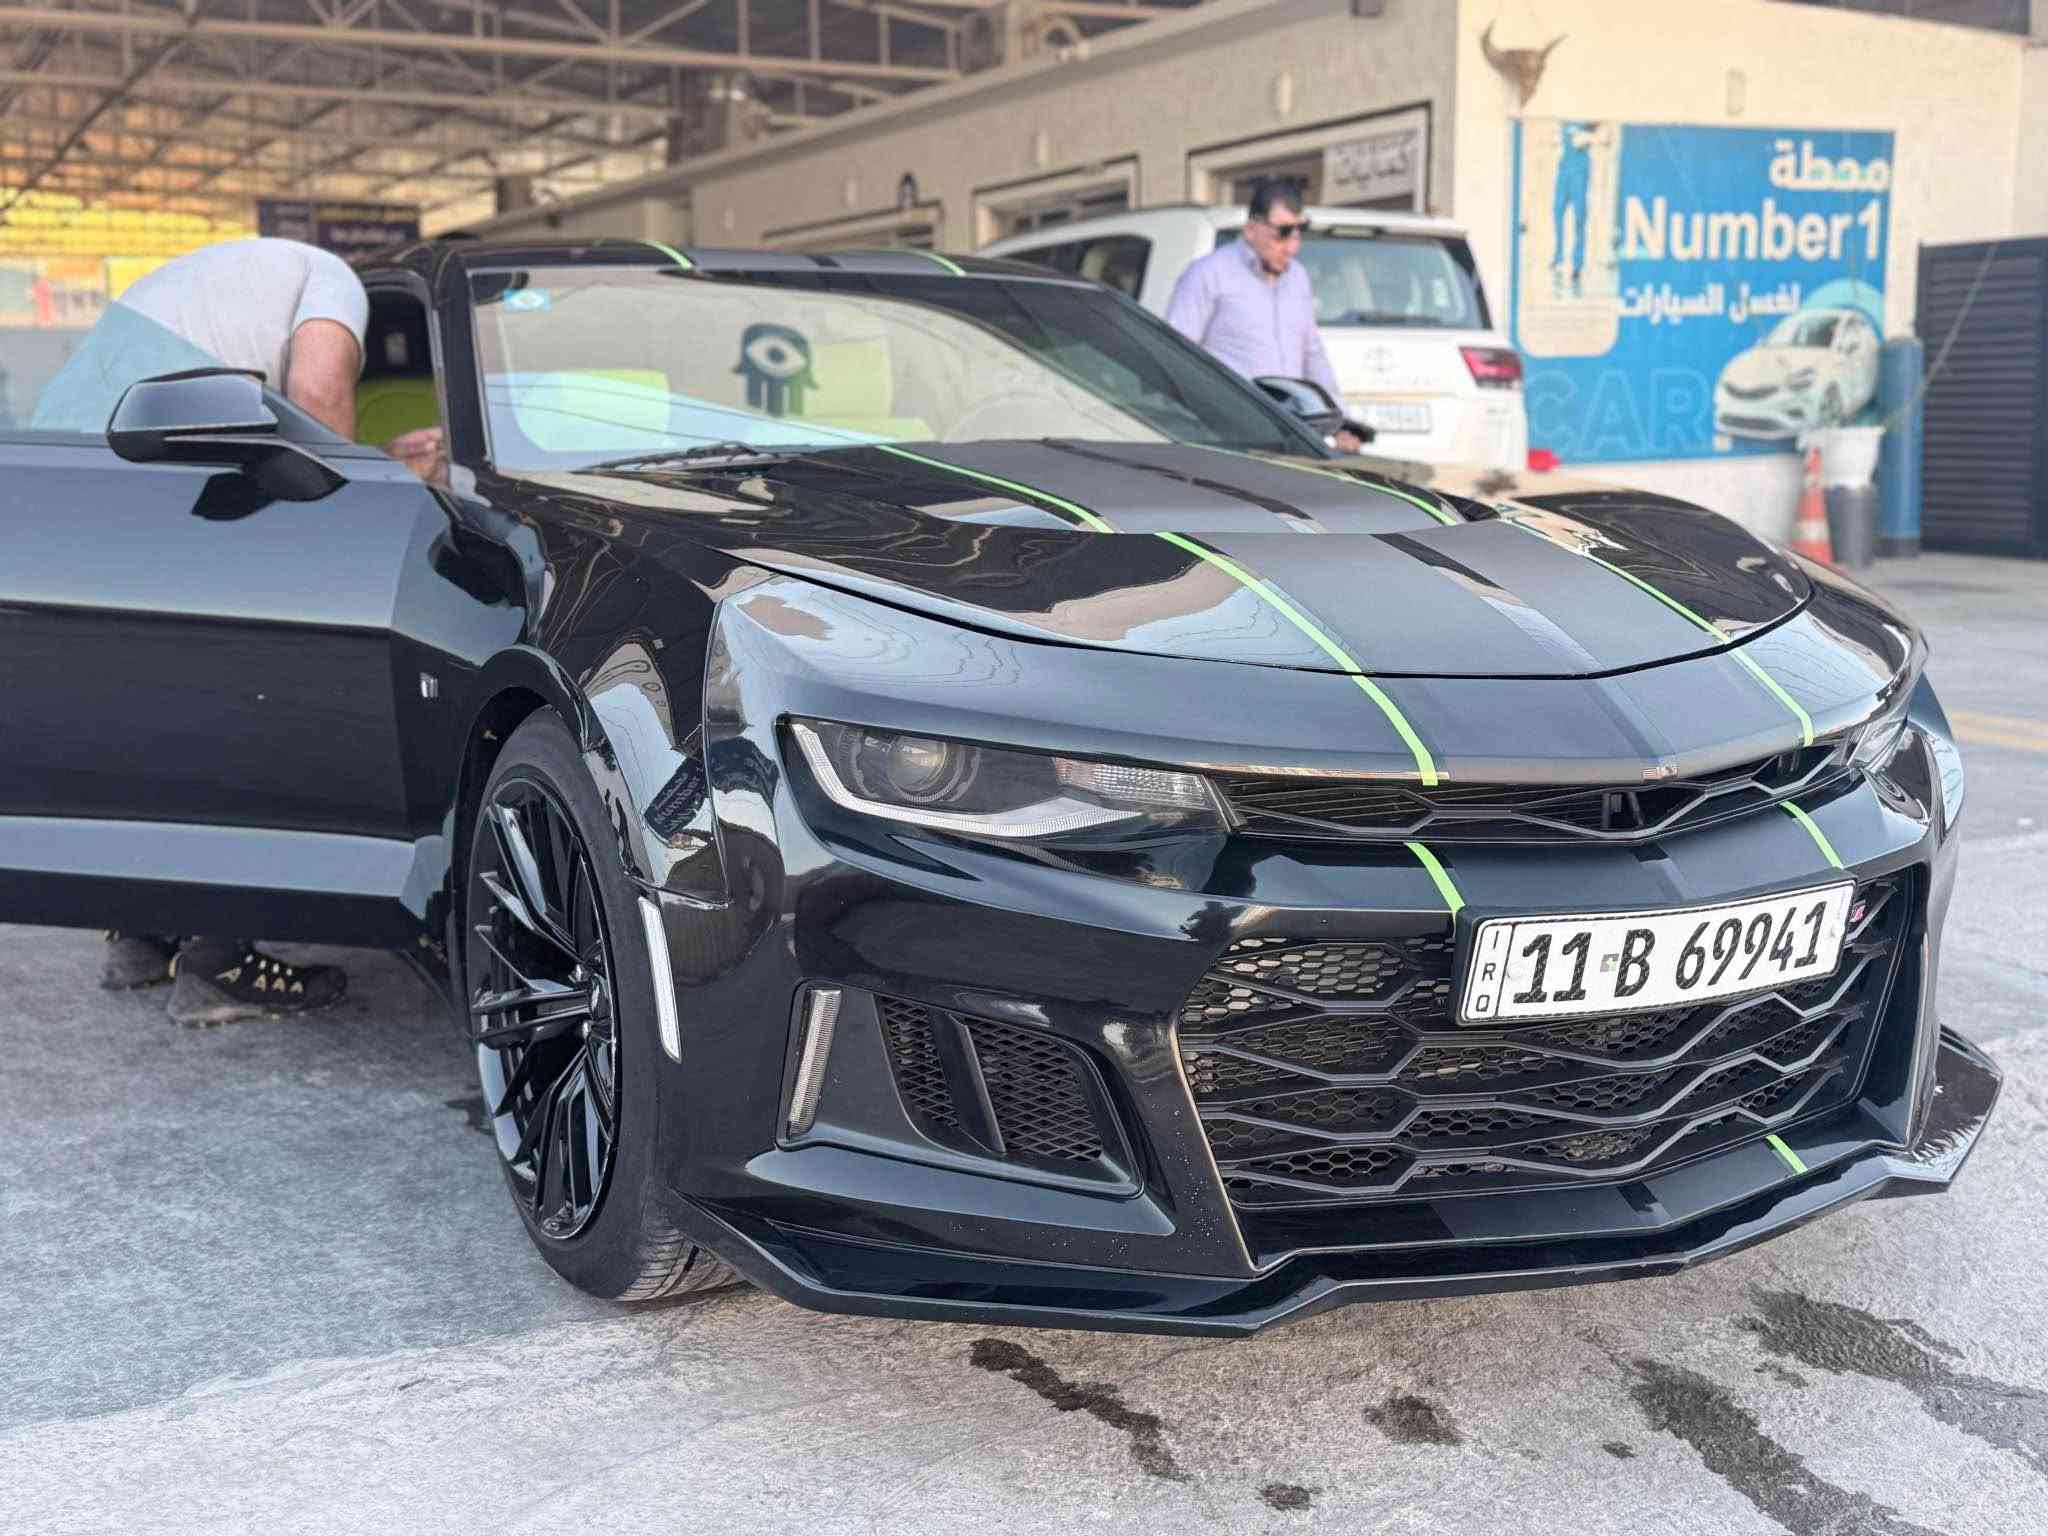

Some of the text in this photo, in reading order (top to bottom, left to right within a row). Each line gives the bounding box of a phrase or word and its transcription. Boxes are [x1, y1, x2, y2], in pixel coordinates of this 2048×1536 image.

[1769, 139, 1889, 191] محطة
[1513, 900, 1827, 1004] 11 B 69941
